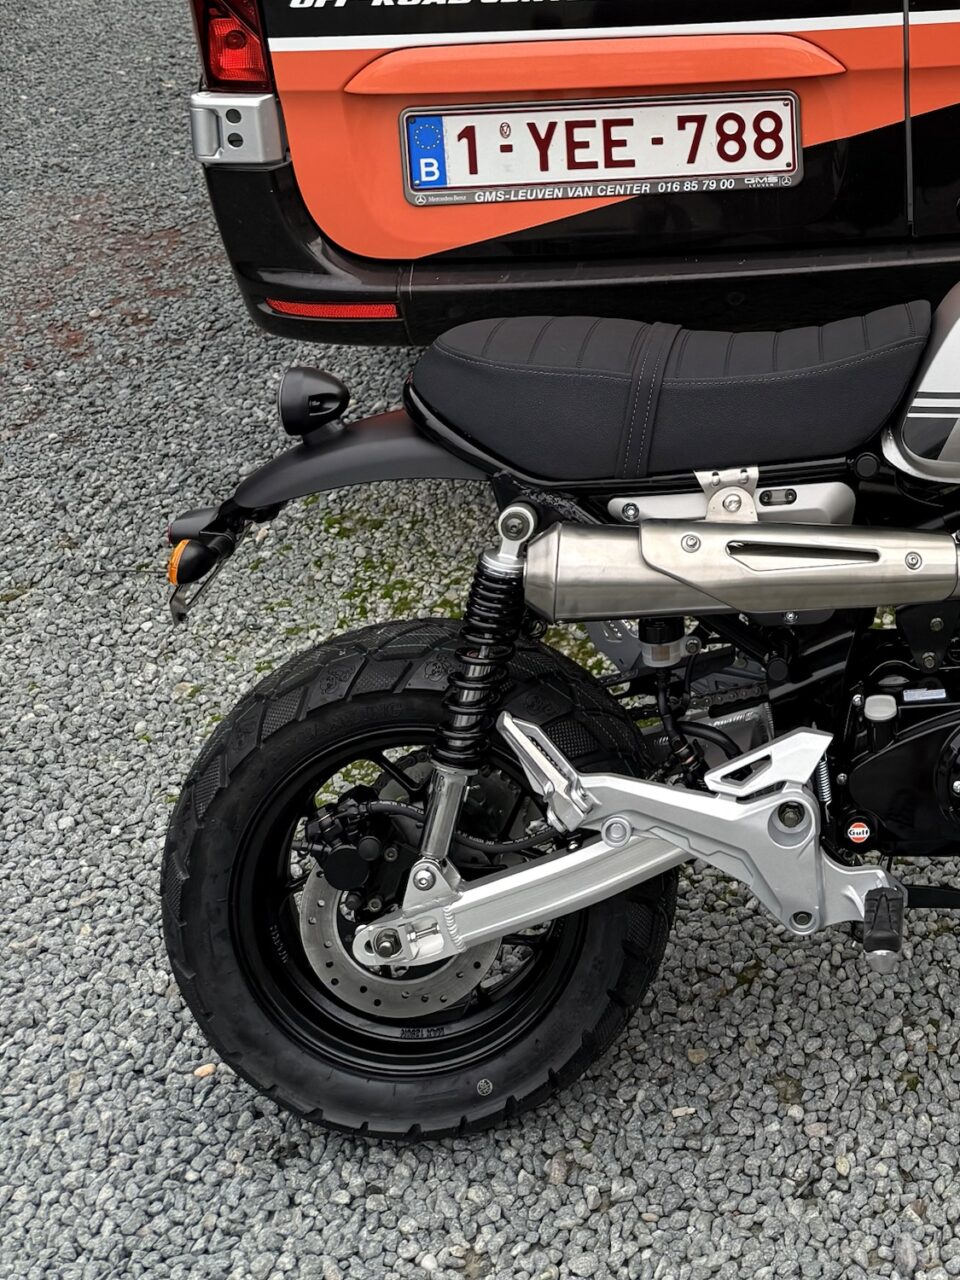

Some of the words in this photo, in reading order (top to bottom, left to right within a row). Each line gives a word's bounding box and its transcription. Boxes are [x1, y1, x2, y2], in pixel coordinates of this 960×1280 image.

[420, 159, 440, 182] B
[744, 176, 778, 185] GMS
[475, 187, 563, 203] GMS-LEUVEN
[567, 186, 595, 199] VAN
[597, 183, 651, 197] CENTER
[658, 180, 681, 192] 016
[683, 180, 699, 192] 85
[702, 179, 718, 190] 79
[720, 178, 735, 190] 00
[848, 828, 870, 837] Gulf
